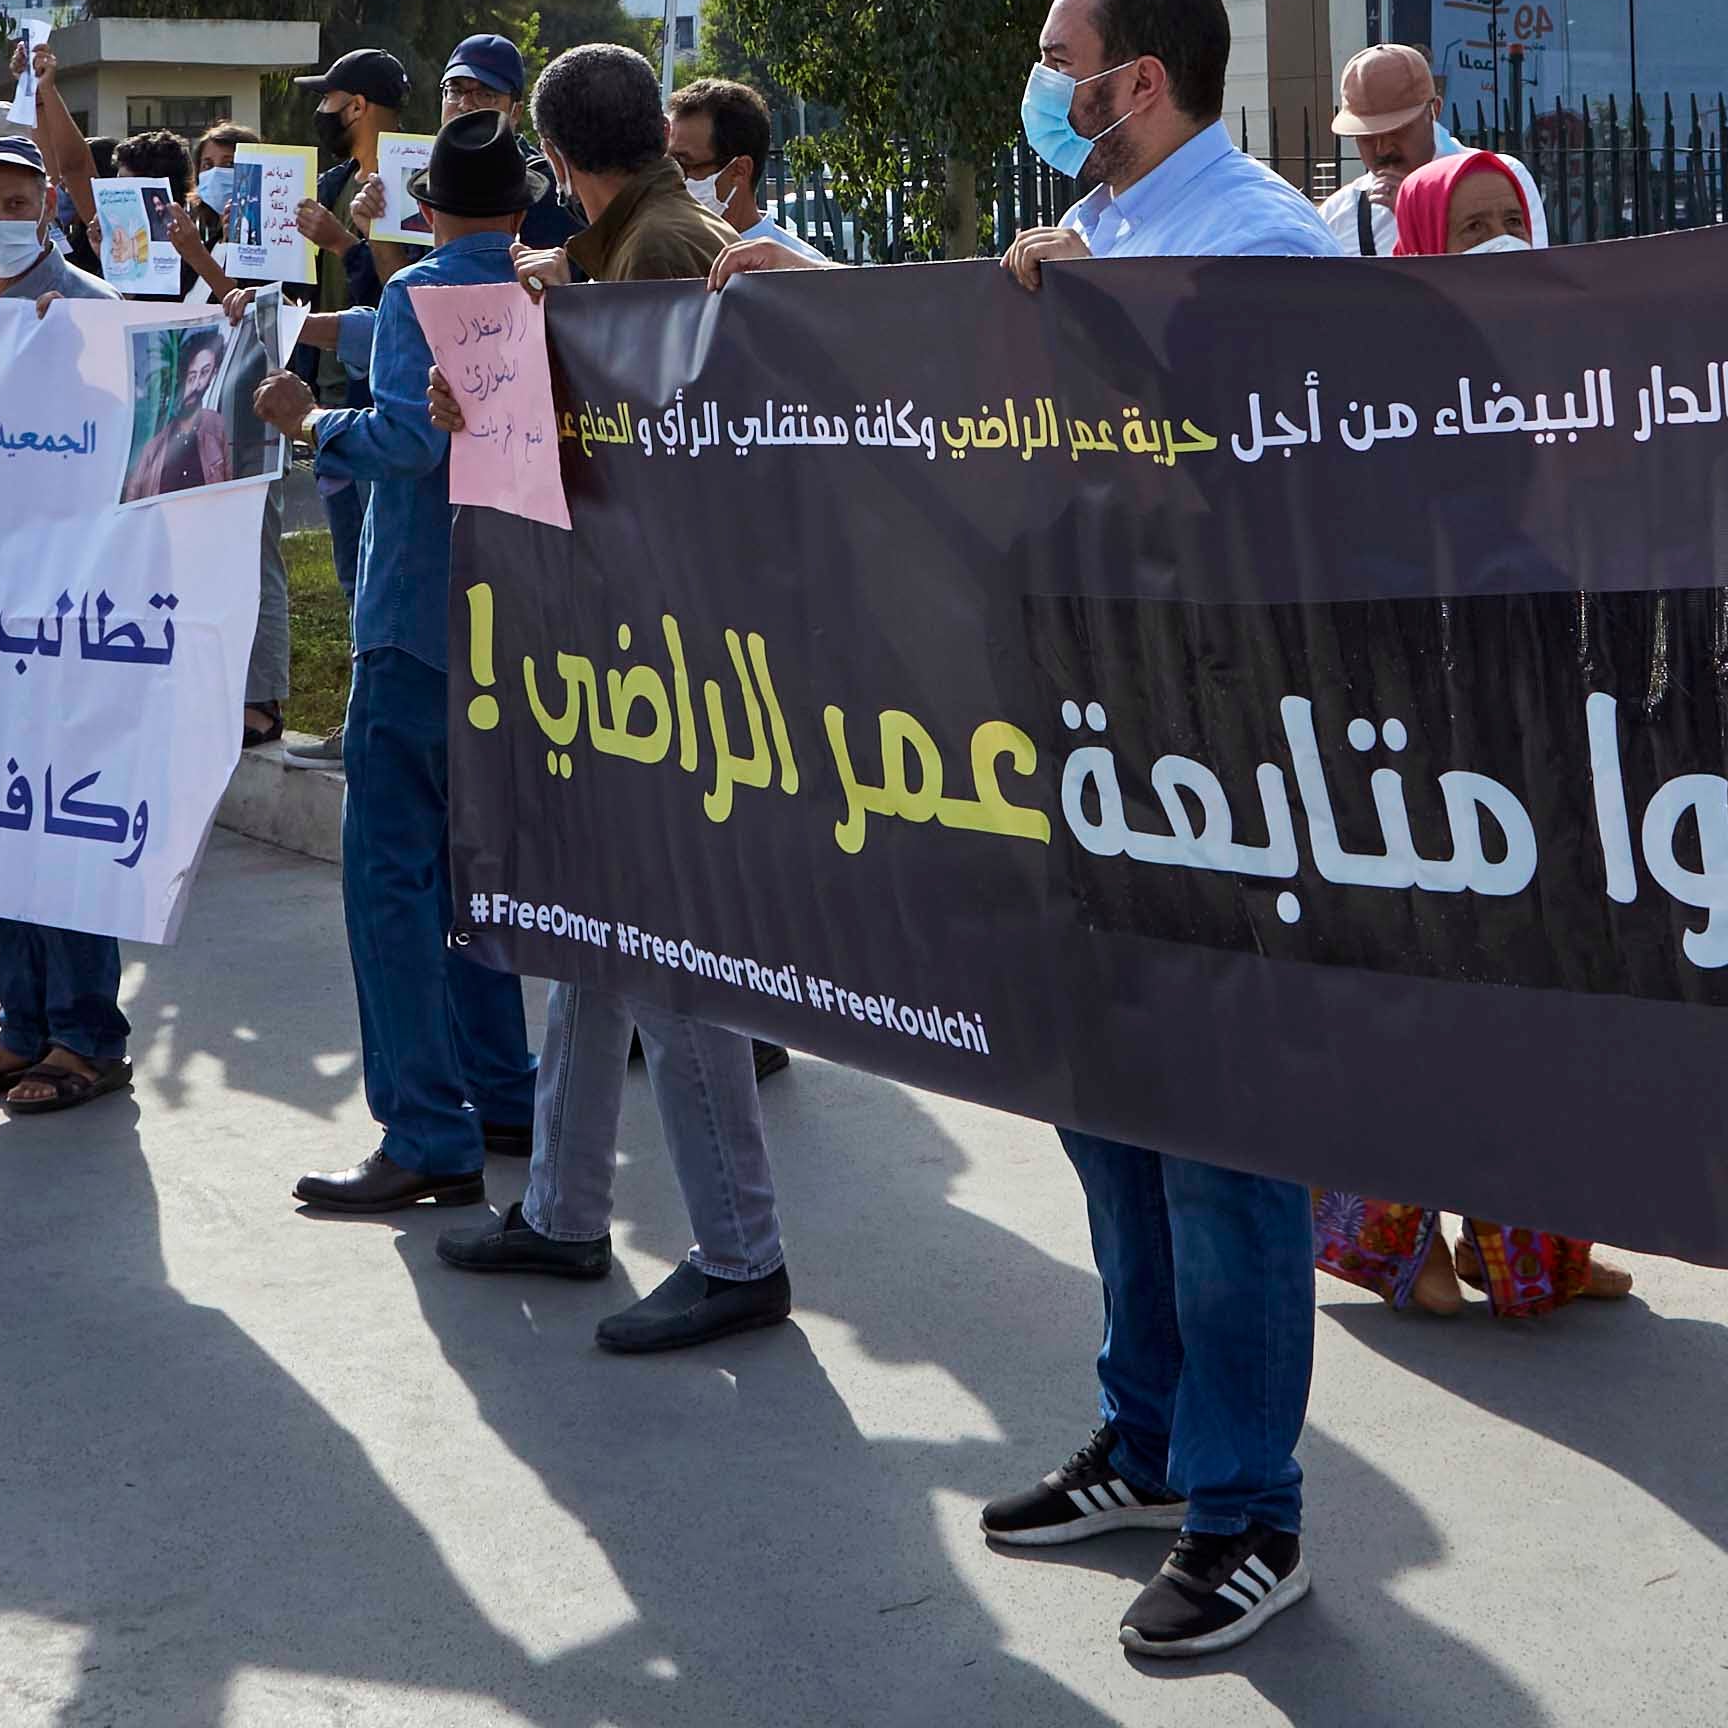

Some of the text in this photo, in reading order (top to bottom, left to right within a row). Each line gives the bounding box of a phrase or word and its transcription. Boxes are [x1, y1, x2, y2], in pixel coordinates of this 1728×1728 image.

[559, 410, 578, 443] ع
[579, 400, 634, 458] الدفاع
[637, 416, 653, 457] و
[656, 387, 720, 458] الرأي
[727, 399, 850, 456] معتقلي
[854, 398, 936, 460] وكافة
[941, 397, 1060, 461] الراضي
[1121, 406, 1218, 467] حرية
[1231, 370, 1321, 463] أجل
[1339, 401, 1419, 452] من
[1434, 368, 1615, 444] البيضاء
[1067, 415, 1119, 461] عمر
[523, 613, 800, 824] الراضي
[823, 703, 1052, 854] عمر
[1060, 694, 1538, 925] متابعة
[469, 892, 991, 1055] #FreeOmar #FreeOmarRadi #FreeKoulchi
